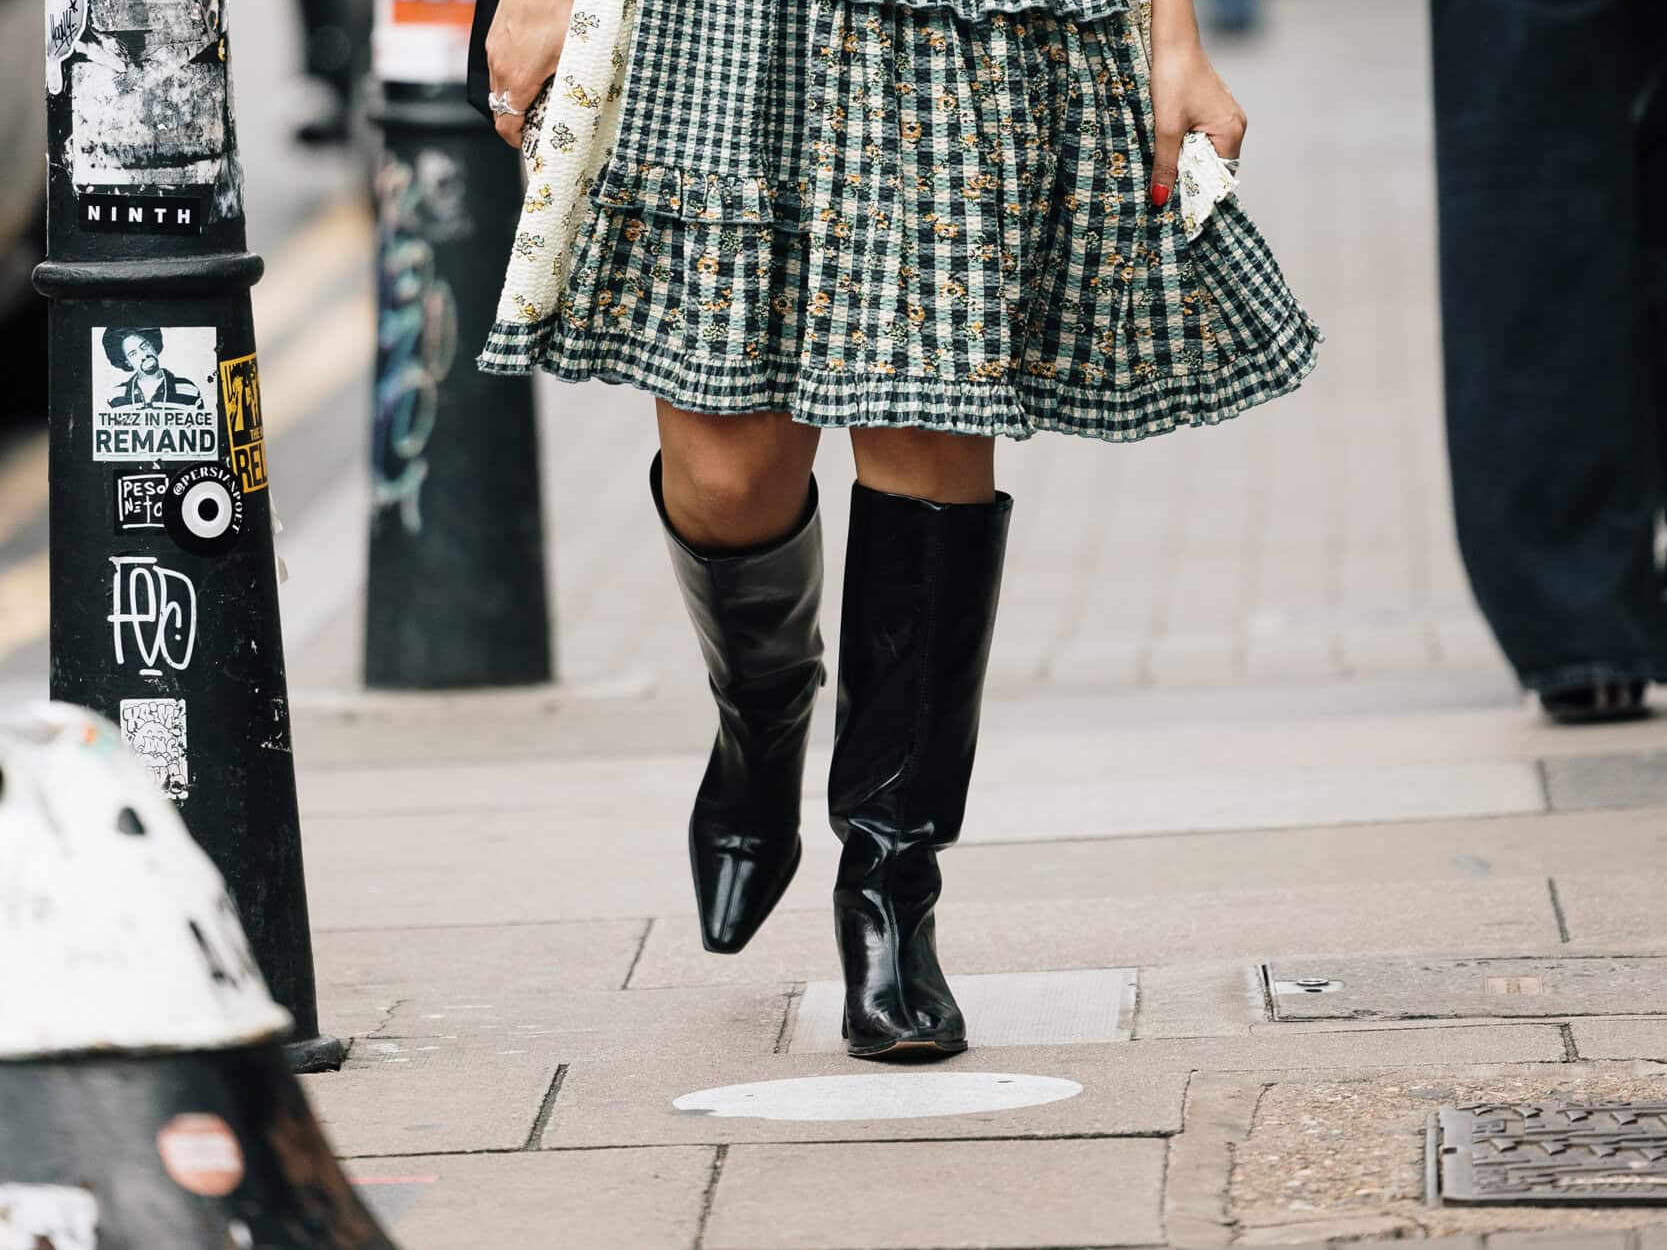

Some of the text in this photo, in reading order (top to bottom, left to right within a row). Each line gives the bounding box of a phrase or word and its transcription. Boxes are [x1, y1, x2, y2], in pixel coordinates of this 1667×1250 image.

[87, 205, 191, 224] NINTH
[145, 412, 160, 426] IN
[164, 412, 213, 426] PEACE
[95, 429, 216, 453] REMAND
